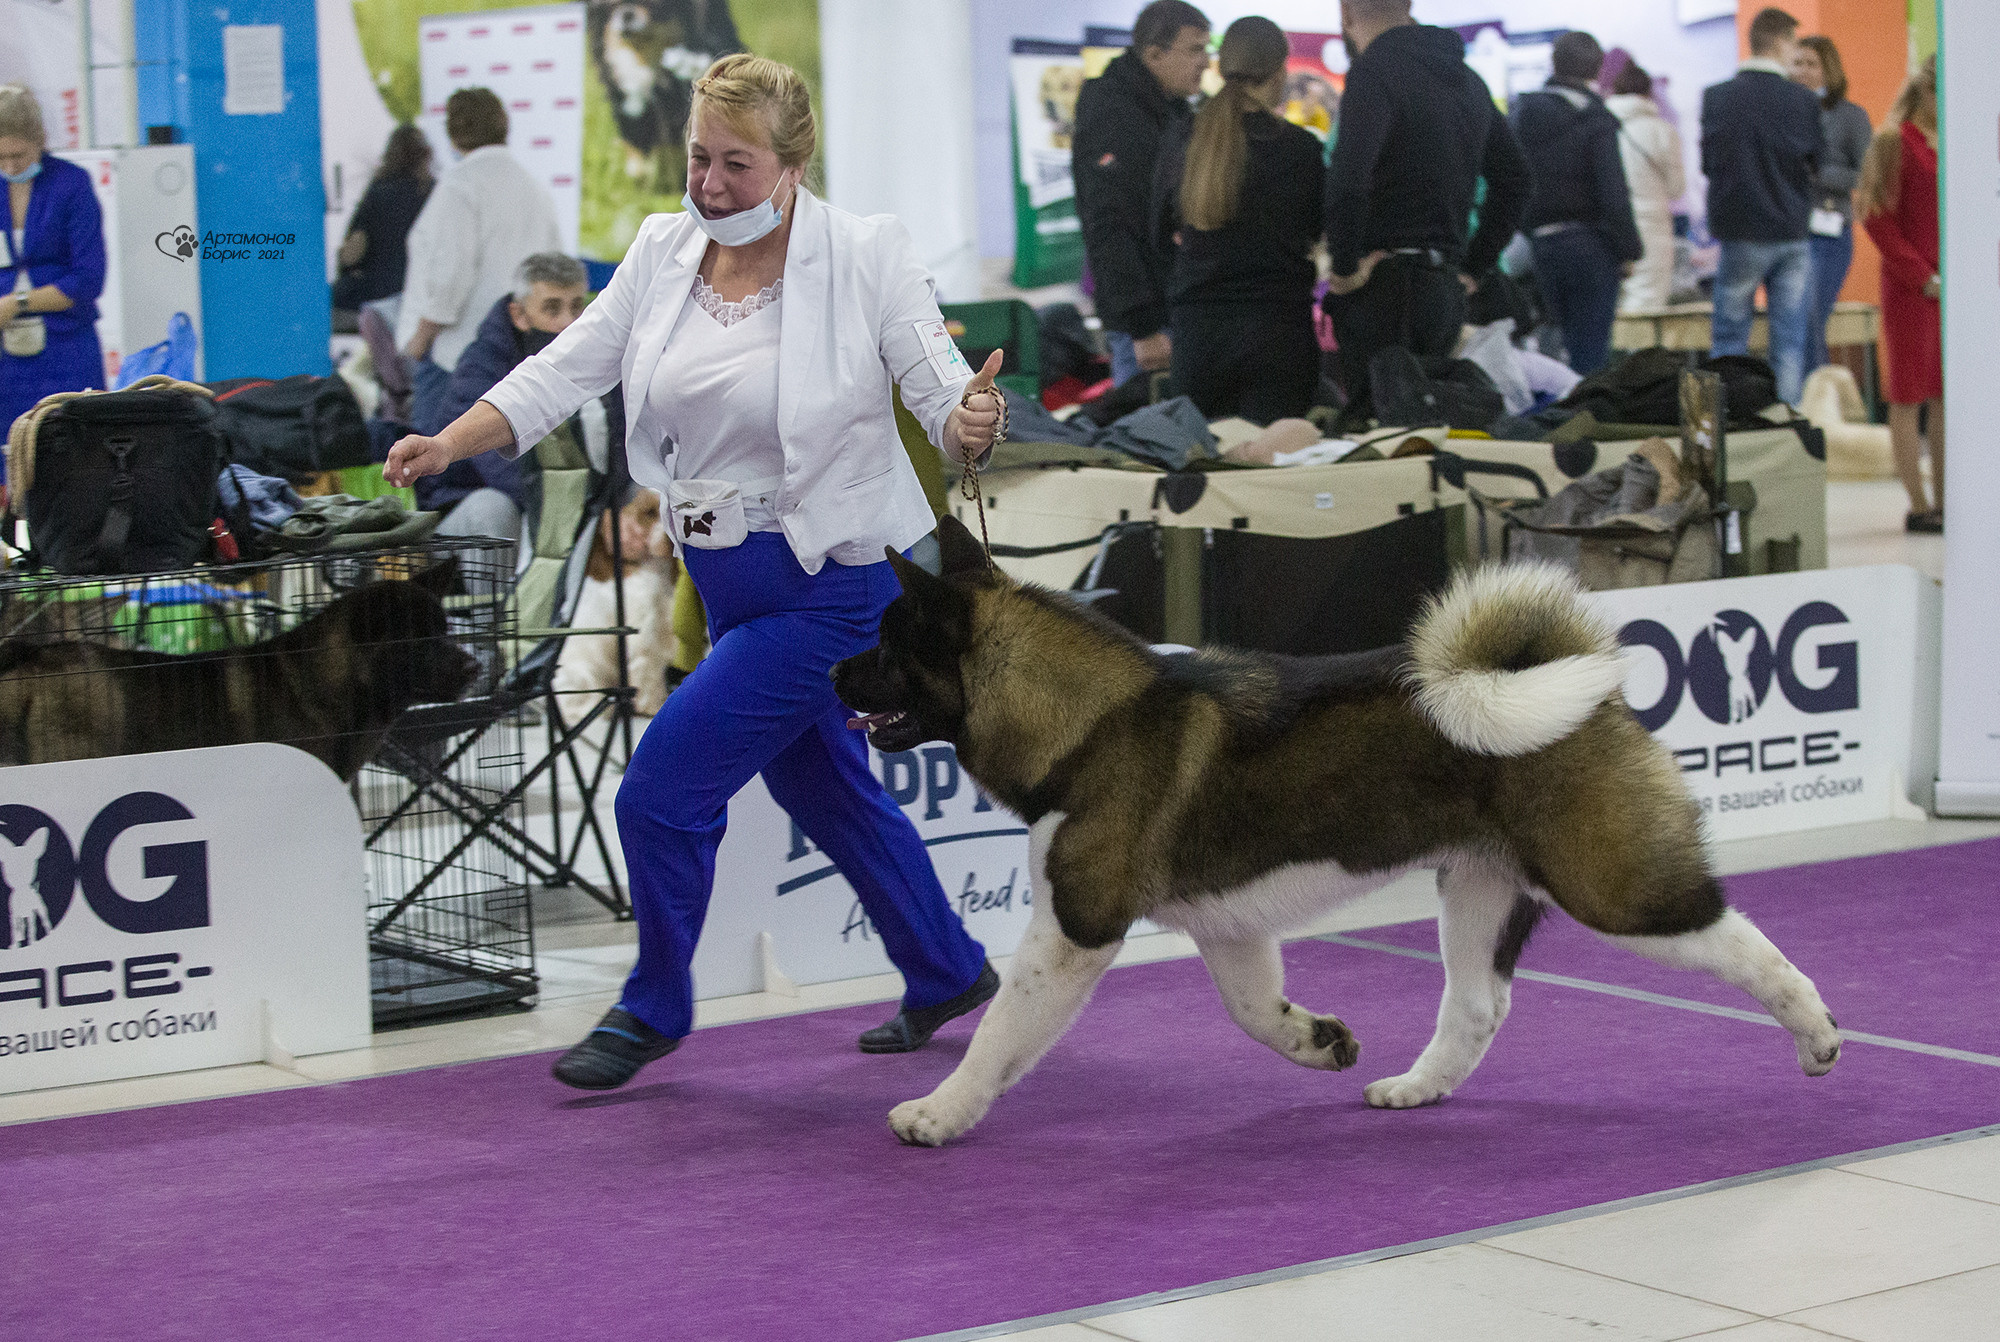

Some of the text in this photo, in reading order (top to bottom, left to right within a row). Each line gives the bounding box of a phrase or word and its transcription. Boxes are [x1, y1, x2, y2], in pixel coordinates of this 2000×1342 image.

[1672, 730, 1861, 778] PACE-
[1719, 782, 1786, 812] вашей
[1791, 774, 1864, 802] собаки
[957, 867, 1019, 925] feed
[106, 1008, 217, 1043] собаки
